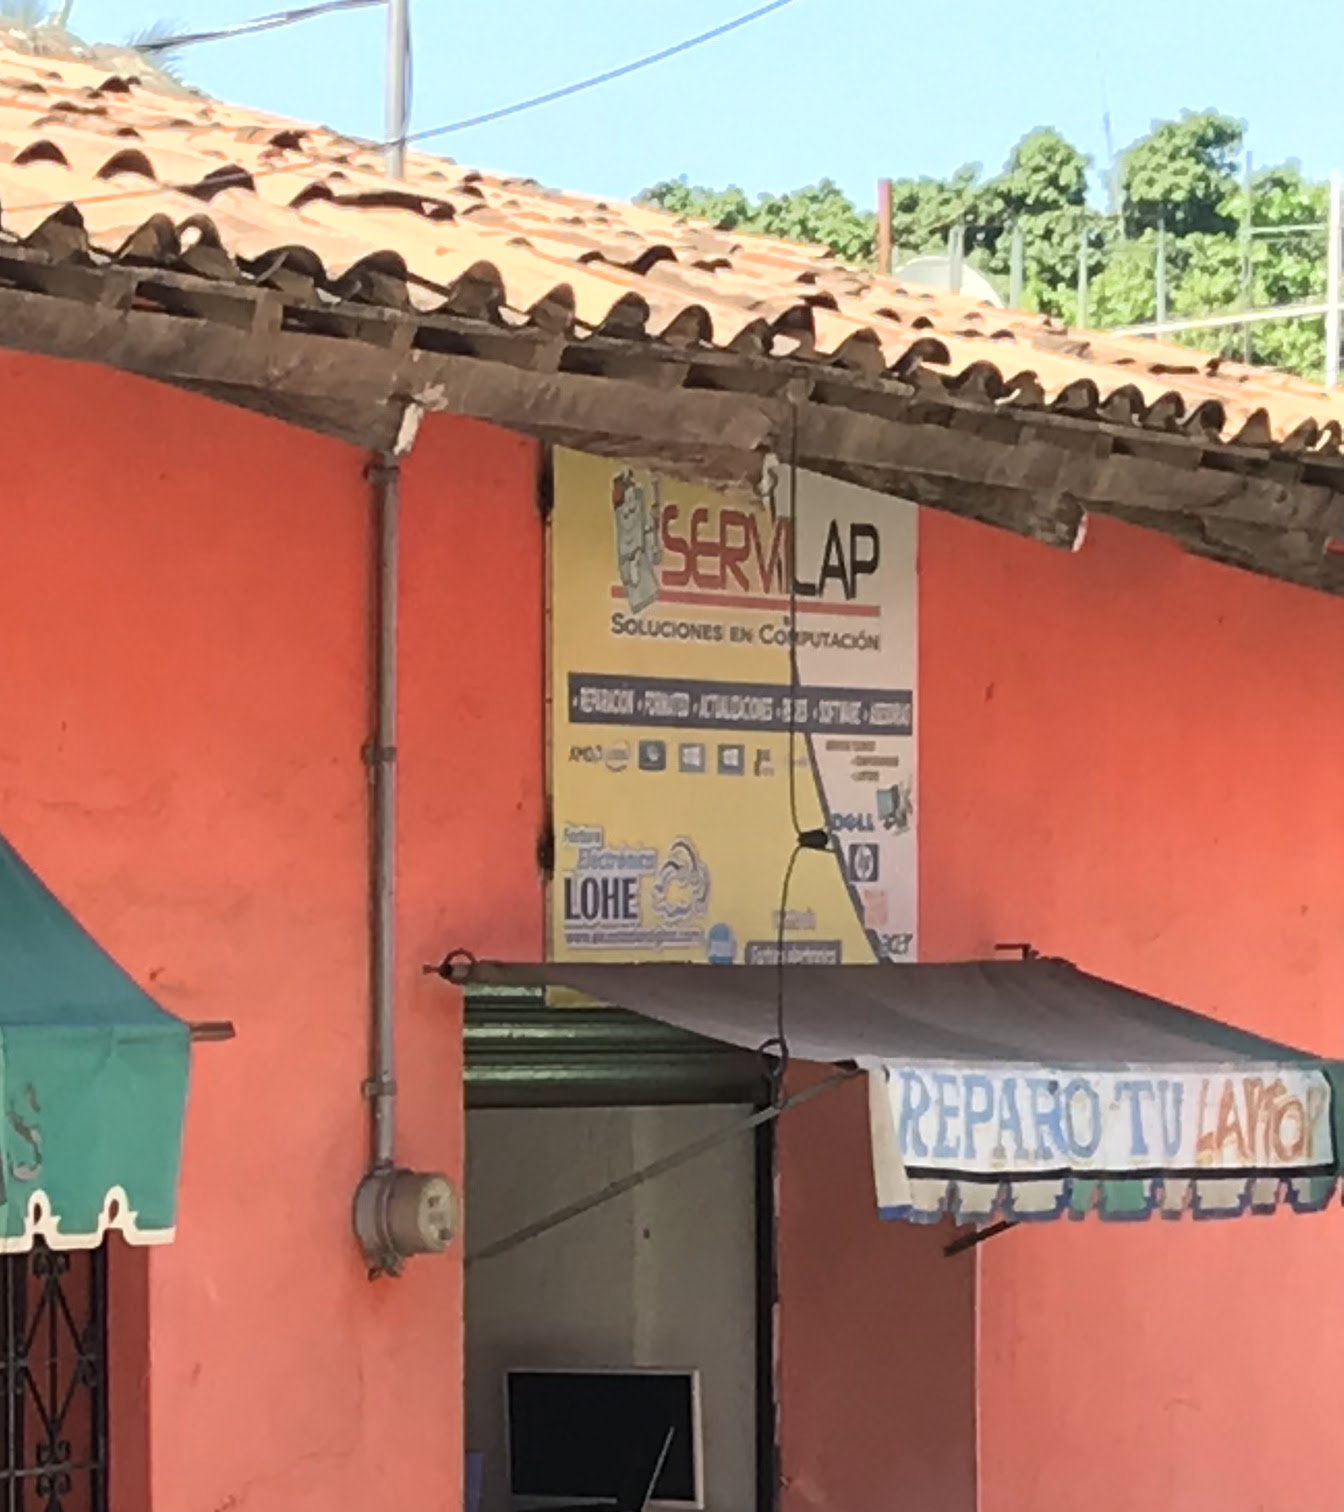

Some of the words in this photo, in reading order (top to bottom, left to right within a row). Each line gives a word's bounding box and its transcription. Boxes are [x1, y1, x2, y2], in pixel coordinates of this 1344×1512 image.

[730, 626, 752, 643] EN
[564, 876, 638, 920] LOHE
[899, 1068, 1100, 1159] REPARO
[1115, 1080, 1184, 1157] TU
